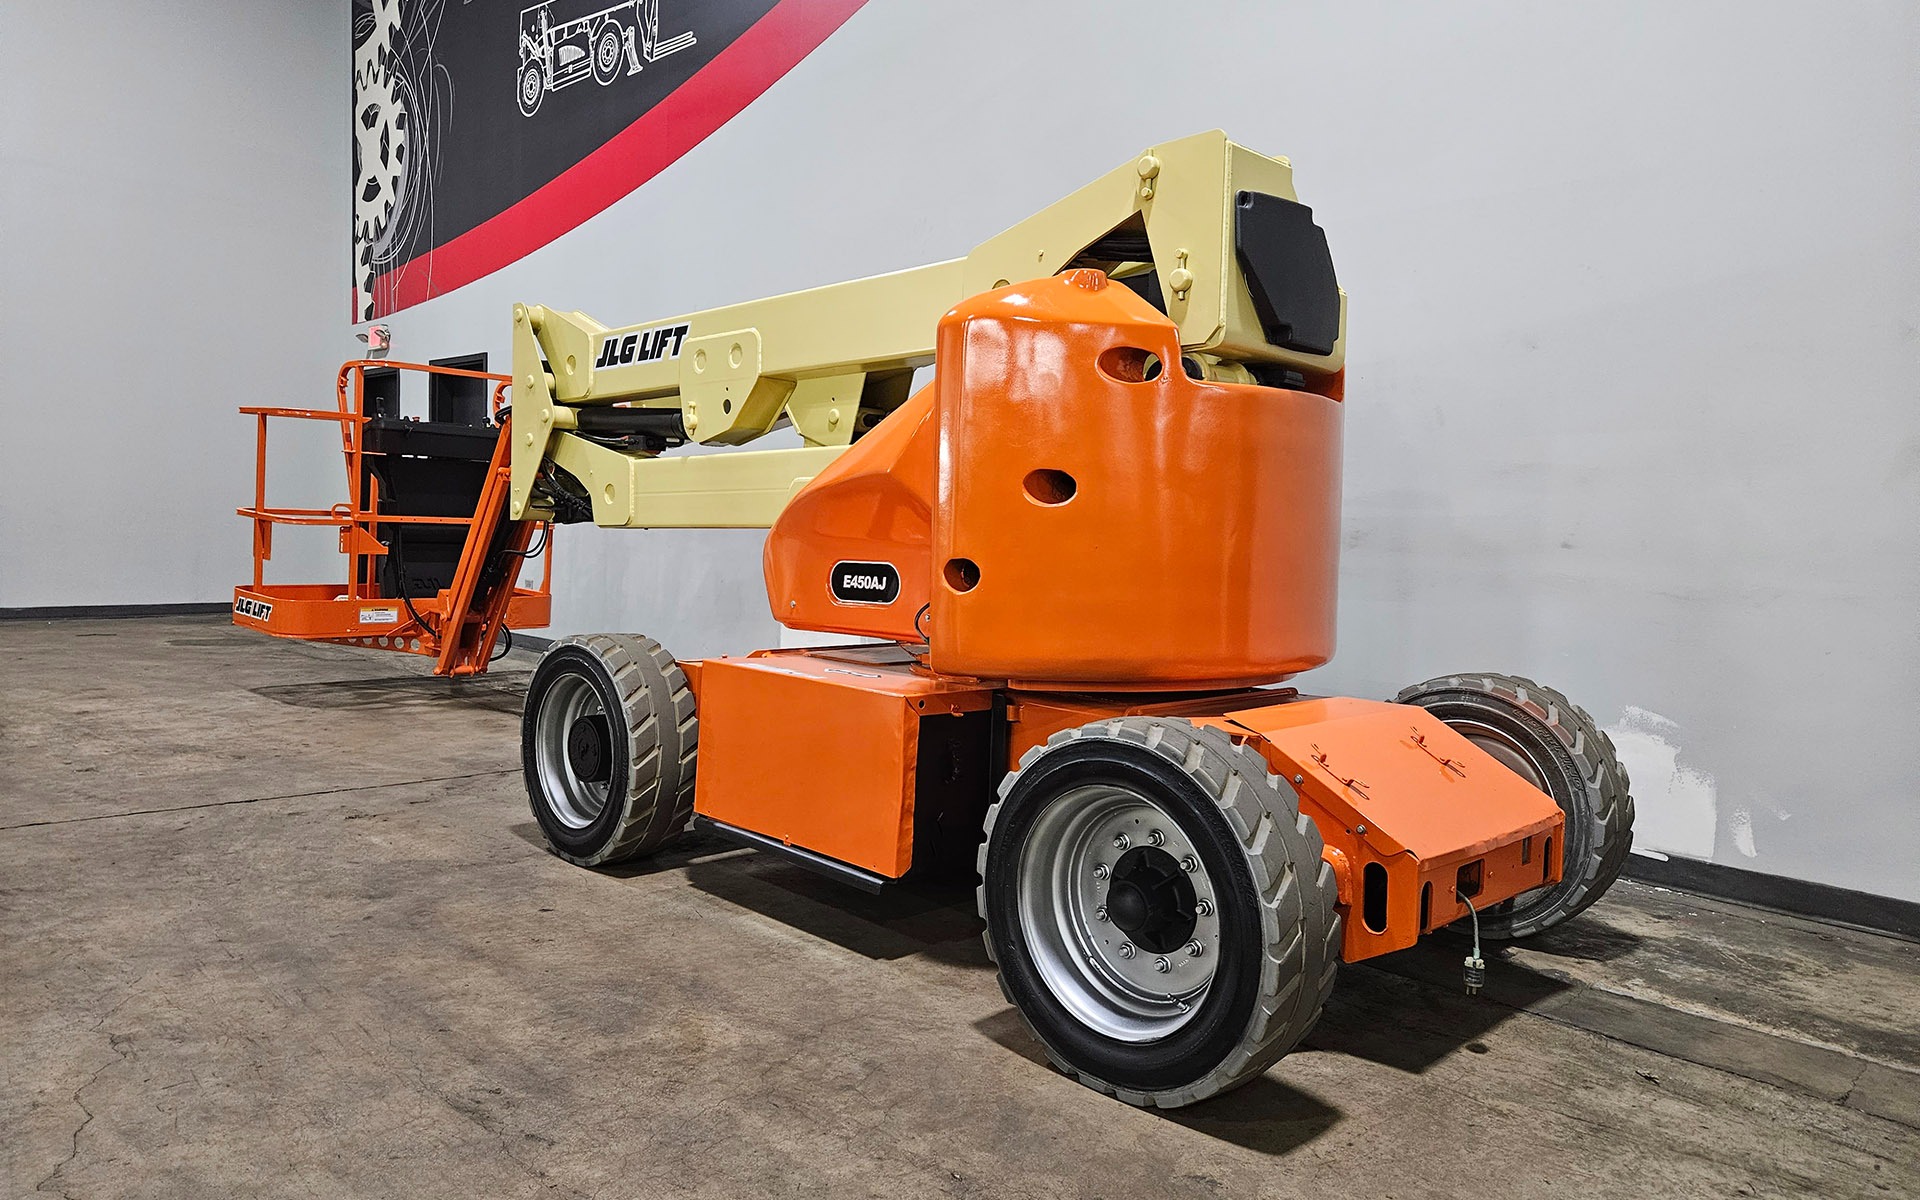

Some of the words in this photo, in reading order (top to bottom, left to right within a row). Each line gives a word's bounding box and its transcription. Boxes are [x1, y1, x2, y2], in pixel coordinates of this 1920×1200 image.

[595, 334, 638, 368] JLG
[637, 324, 689, 362] LIFT
[842, 574, 887, 591] E450AJ
[235, 597, 252, 615] JLG
[252, 602, 272, 620] LIFT
